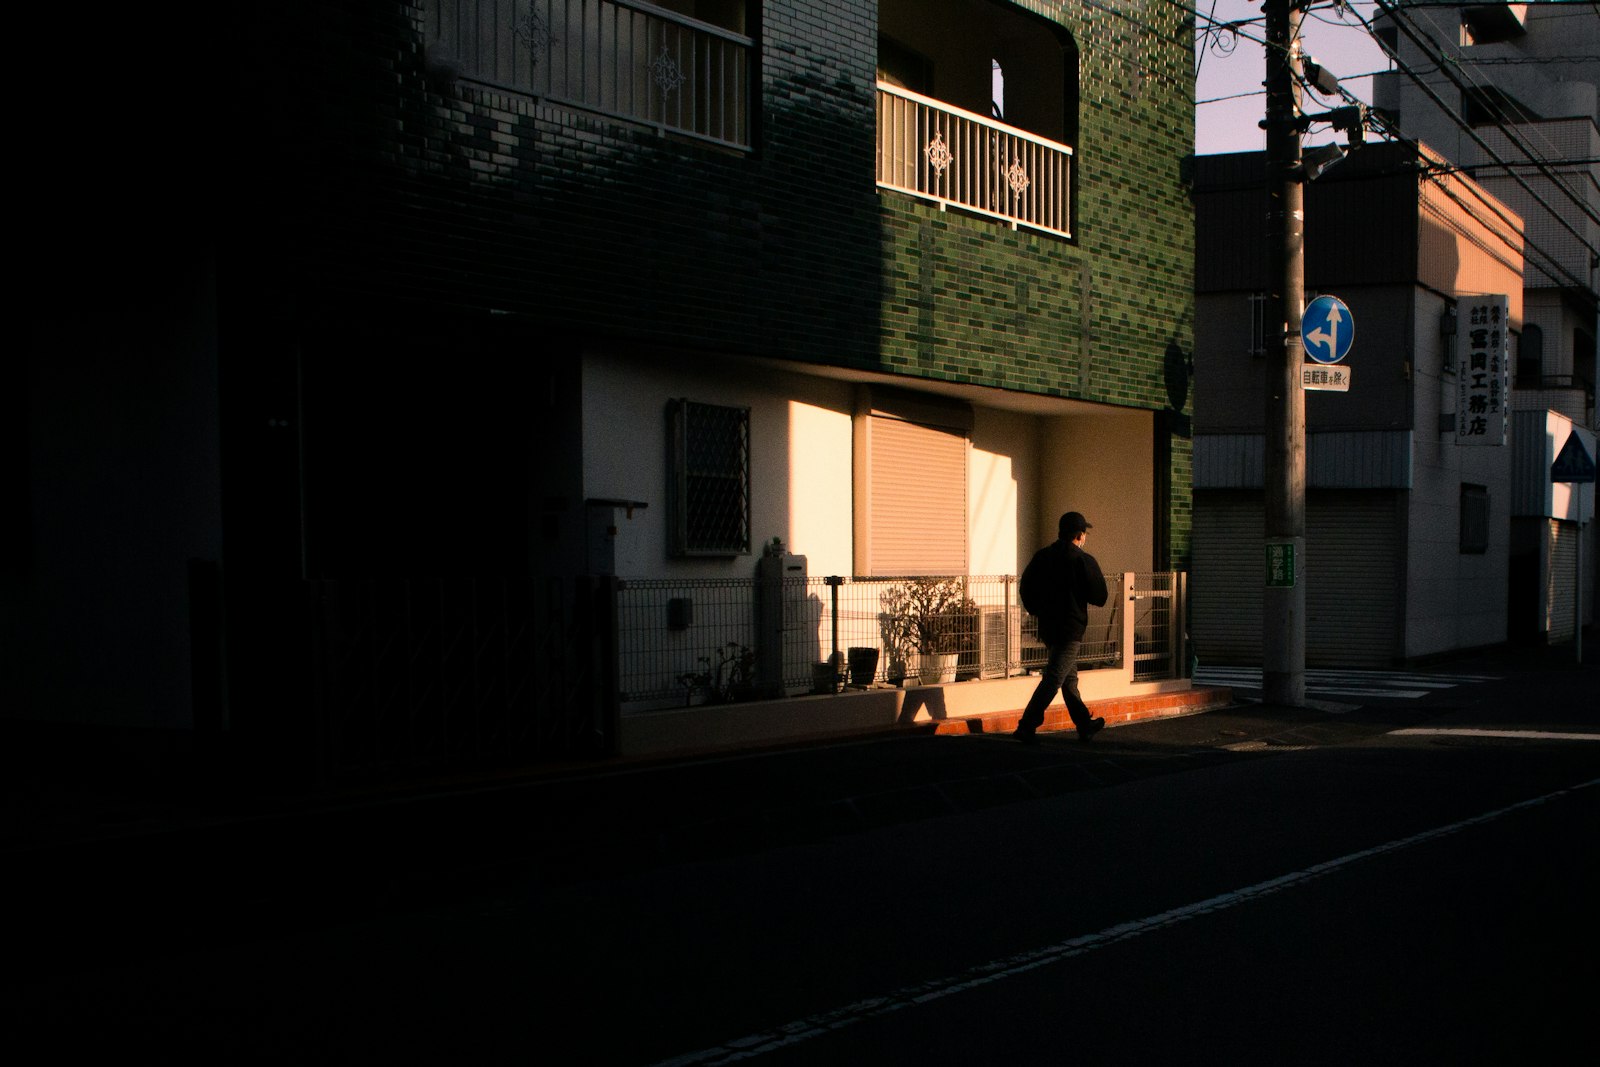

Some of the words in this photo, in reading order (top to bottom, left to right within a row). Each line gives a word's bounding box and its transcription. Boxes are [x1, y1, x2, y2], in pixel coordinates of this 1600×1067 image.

[1303, 369, 1347, 386] 自転車を除く
[1271, 546, 1284, 581] 通学路
